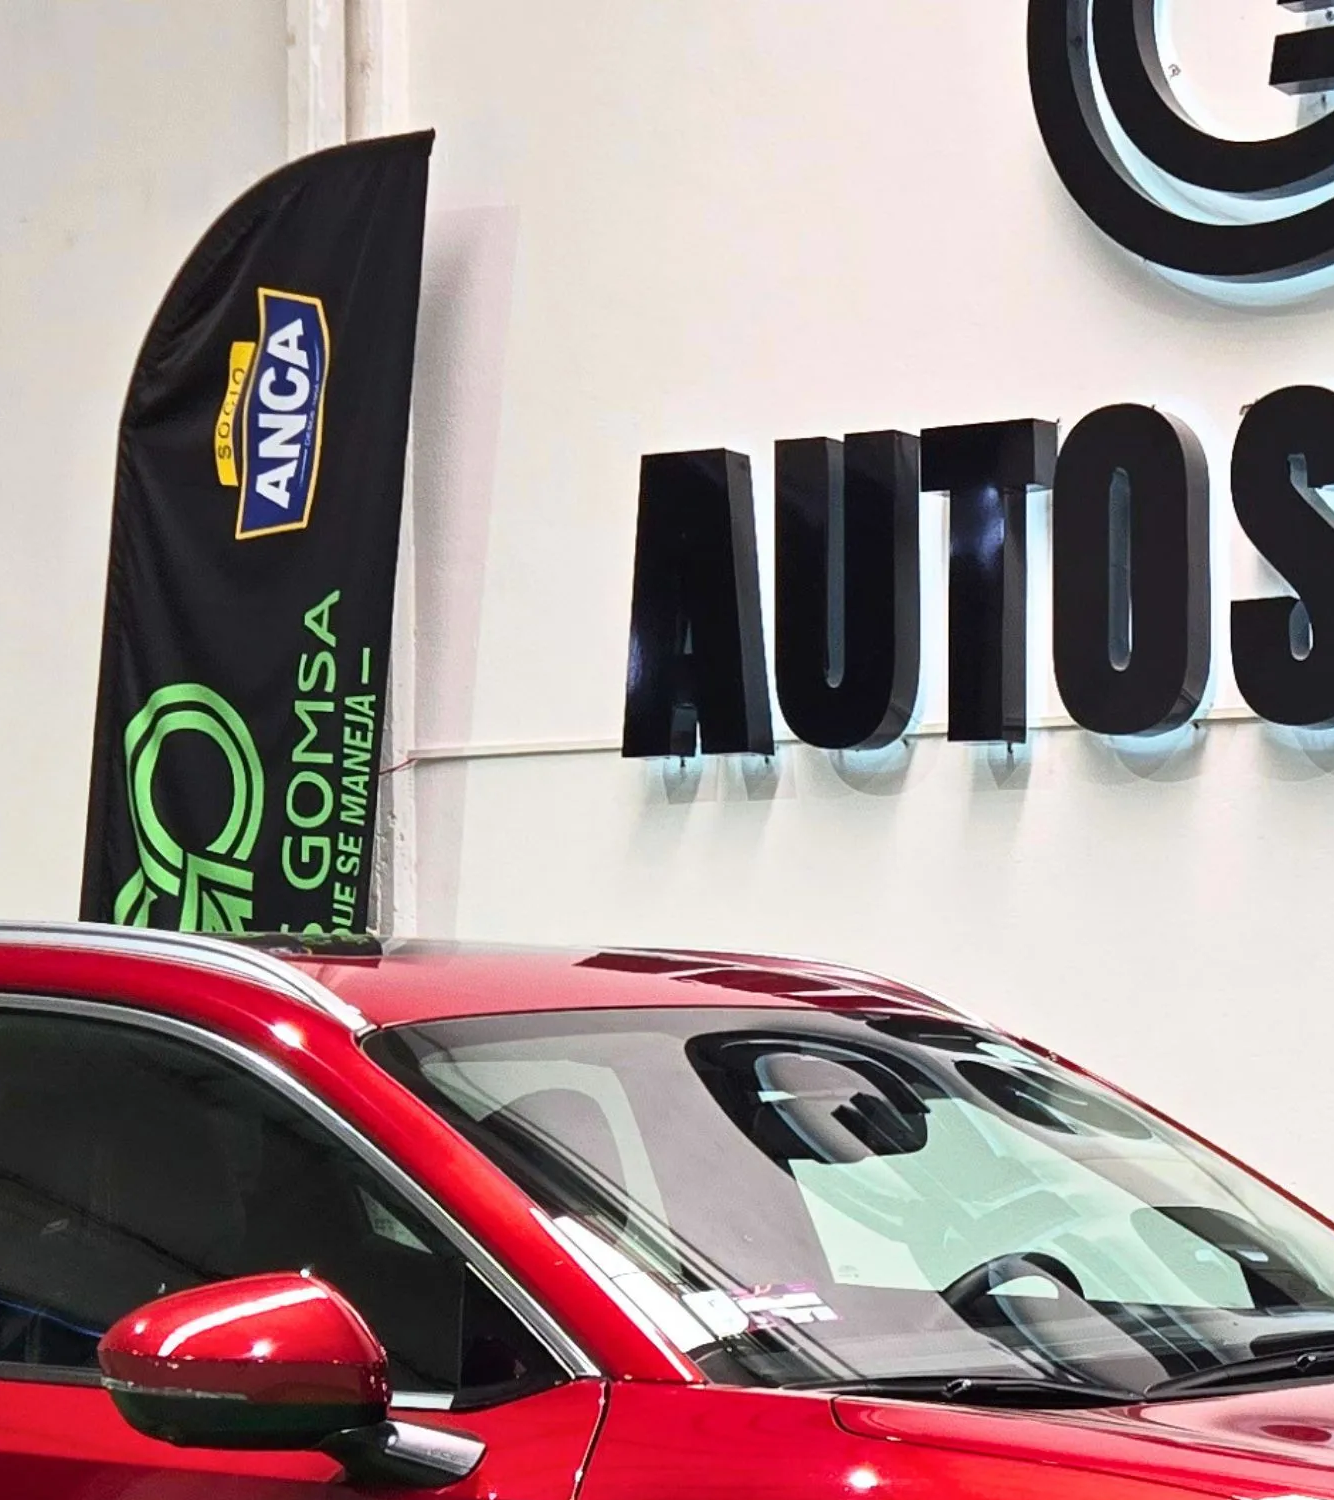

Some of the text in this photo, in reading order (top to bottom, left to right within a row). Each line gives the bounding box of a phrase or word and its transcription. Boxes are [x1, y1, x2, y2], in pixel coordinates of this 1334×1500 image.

[217, 367, 245, 460] SOCIO
[255, 318, 311, 509] ANCA
[282, 590, 340, 889] GOMSA
[339, 695, 376, 826] MANEJA
[335, 832, 363, 876] SE
